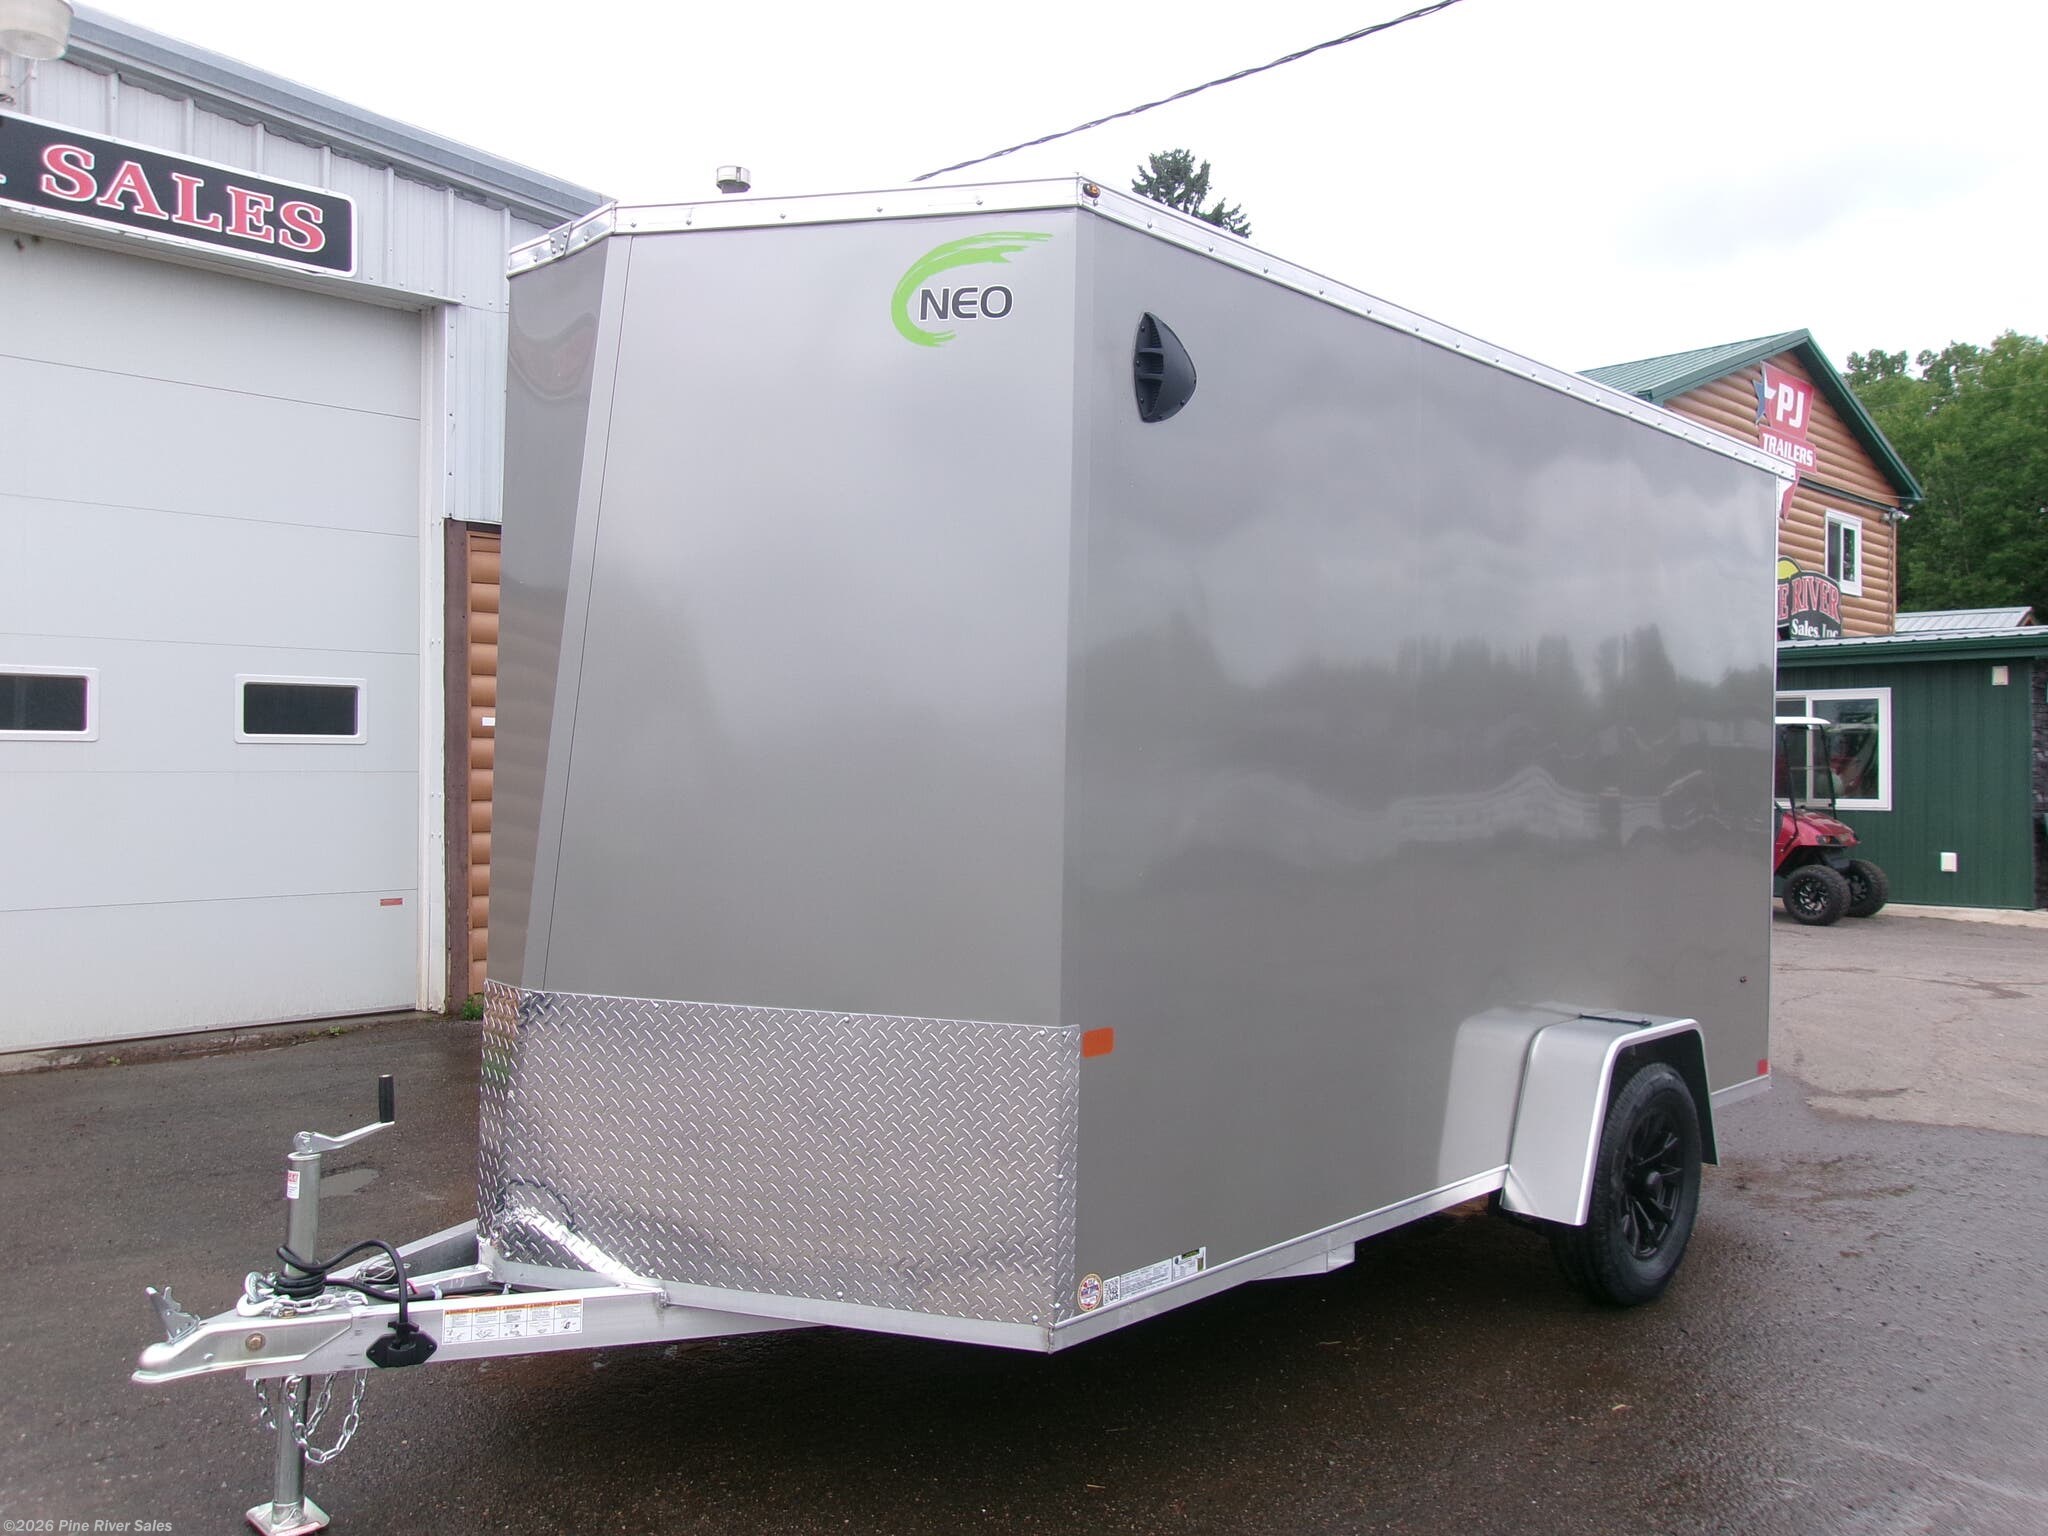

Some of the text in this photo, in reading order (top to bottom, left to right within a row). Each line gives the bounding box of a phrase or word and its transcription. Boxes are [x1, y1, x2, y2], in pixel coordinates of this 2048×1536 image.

[41, 144, 326, 252] SALES
[919, 285, 1013, 321] NEO
[1776, 382, 1804, 428] PJ
[1763, 433, 1813, 466] TRAILERS
[1791, 576, 1840, 624] RIVER
